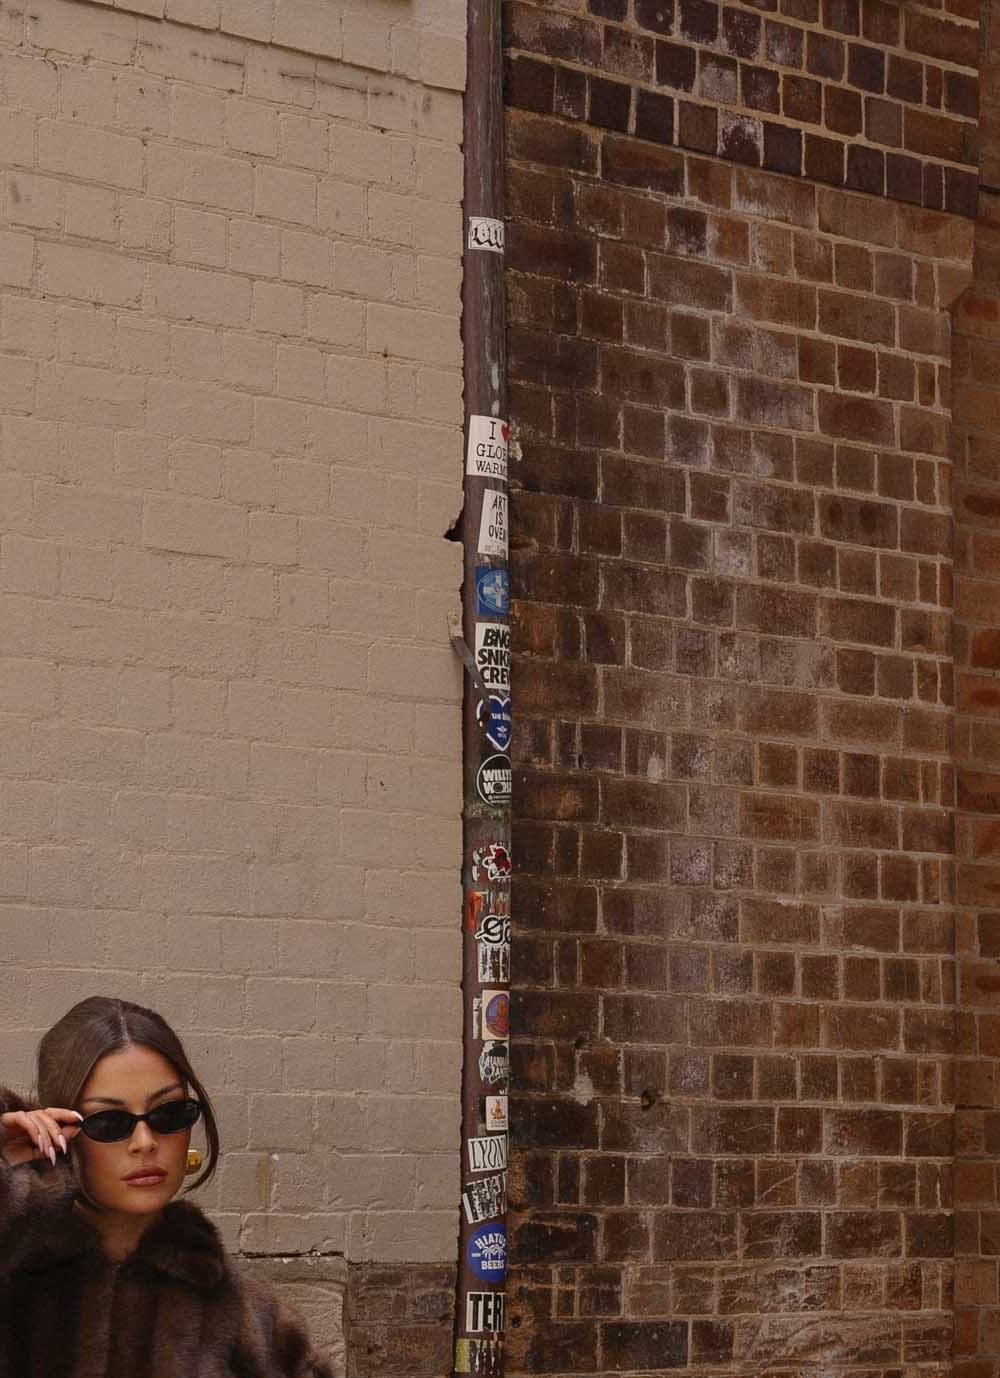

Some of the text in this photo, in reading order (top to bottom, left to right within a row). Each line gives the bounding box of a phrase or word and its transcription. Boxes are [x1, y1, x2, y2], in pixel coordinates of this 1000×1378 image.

[489, 421, 496, 440] I
[492, 495, 506, 512] ART
[495, 511, 503, 526] IS
[478, 648, 511, 667] SNK
